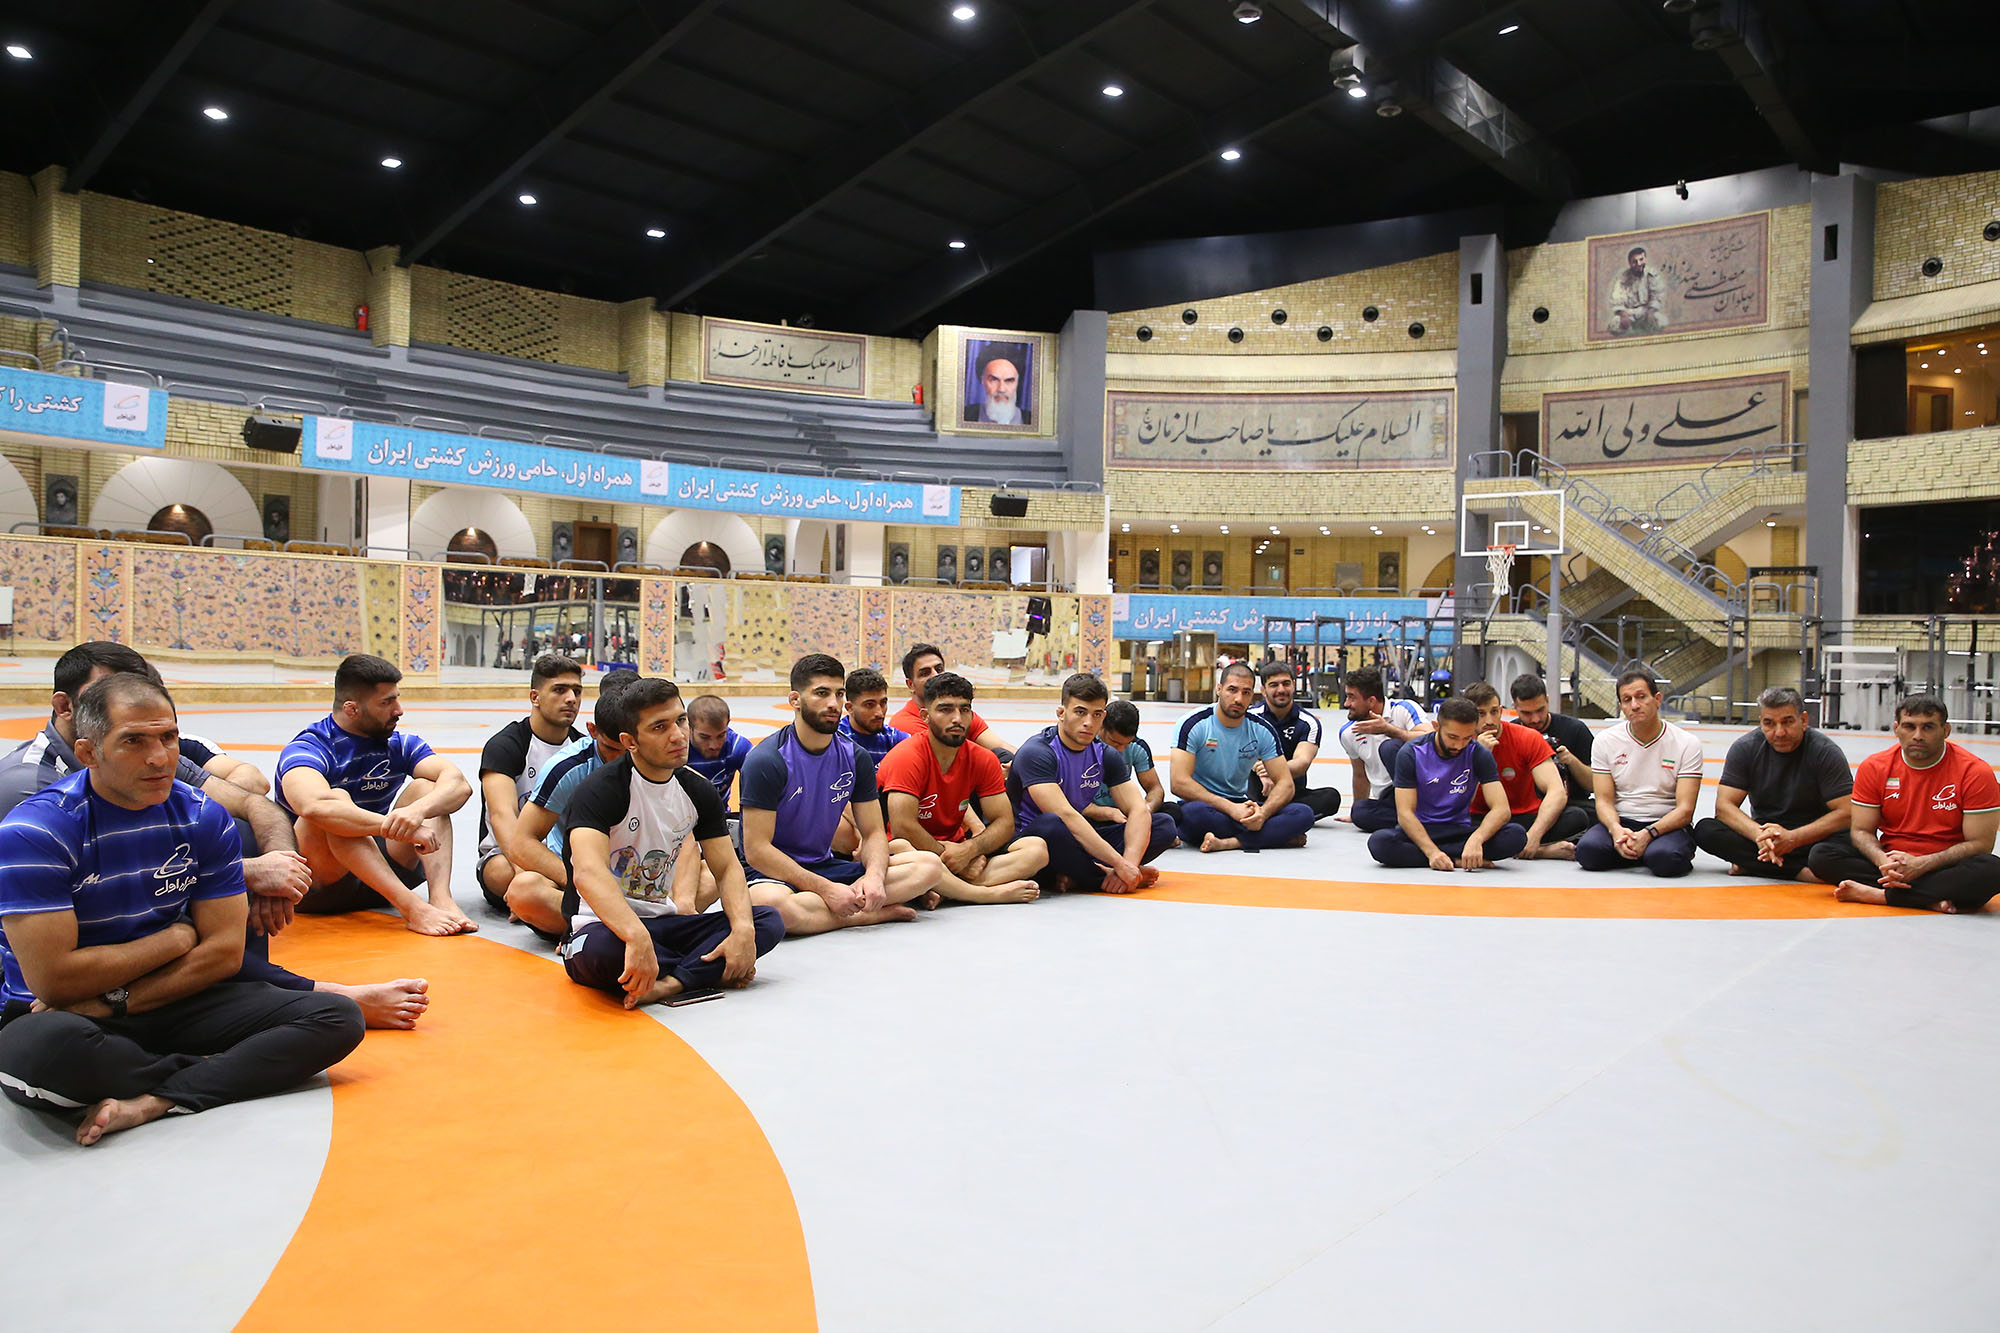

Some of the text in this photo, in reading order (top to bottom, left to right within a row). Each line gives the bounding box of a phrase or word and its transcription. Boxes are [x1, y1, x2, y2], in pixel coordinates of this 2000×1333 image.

[825, 355, 859, 387] السلام
[9, 387, 24, 411] را
[27, 395, 83, 414] کشتی
[1138, 410, 1200, 445] الزمان
[1186, 417, 1264, 455] صاحب
[1555, 391, 1778, 458] علی ولی الله
[1357, 409, 1421, 469] السلام
[367, 437, 413, 466] ایران
[413, 446, 467, 470] کشتی
[468, 449, 516, 479] ورزش
[517, 458, 558, 481] حامی
[593, 464, 634, 490] همراه
[677, 477, 714, 500] ایران
[715, 481, 760, 503] کشتی
[760, 483, 803, 508] ورزش
[805, 488, 842, 509] حامی
[875, 491, 914, 515] همراه
[1133, 607, 1176, 630] ایران
[1178, 608, 1230, 630] کشتی
[154, 877, 181, 897] اول
